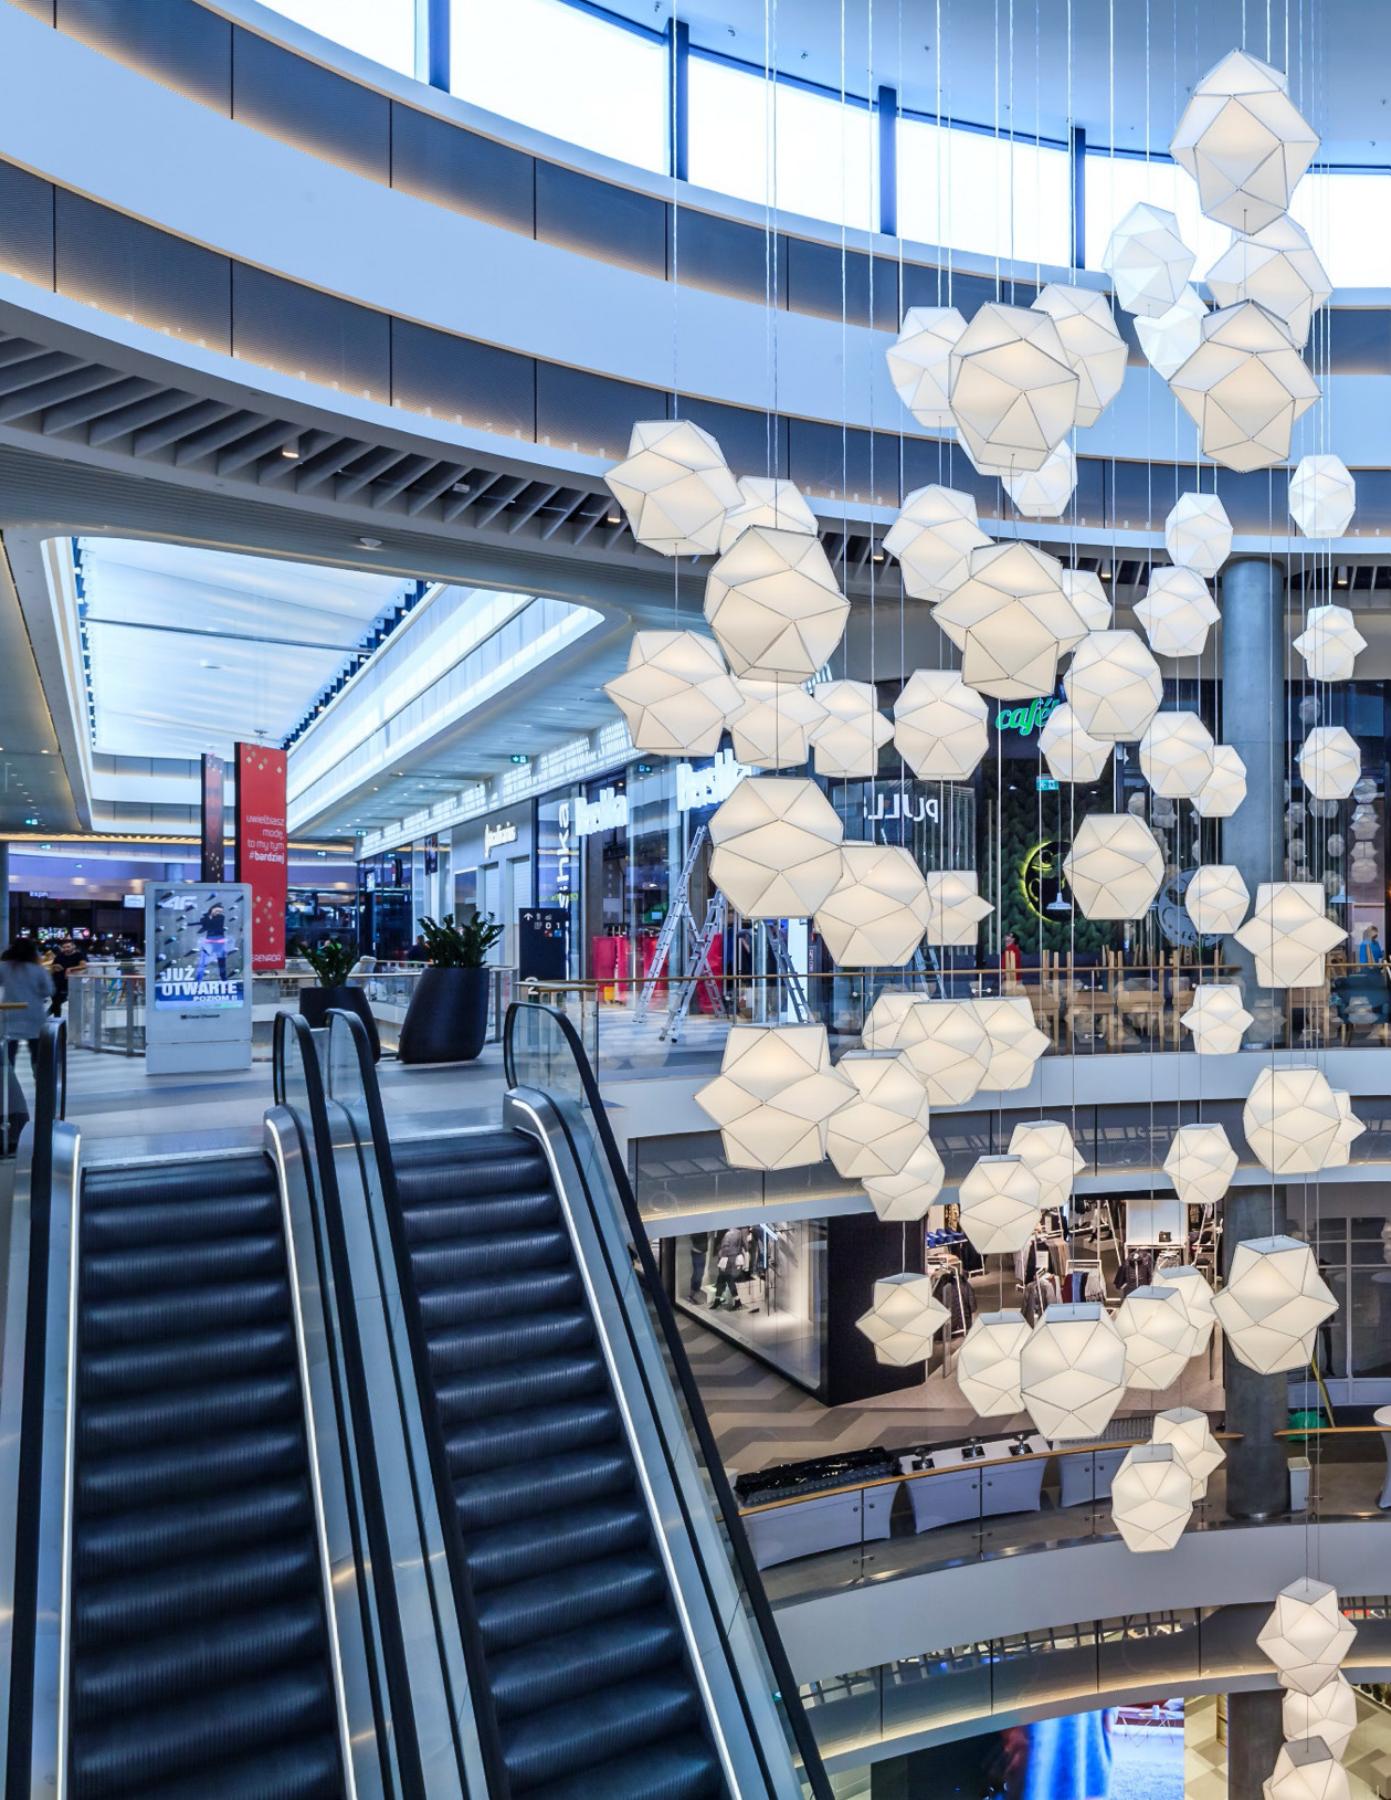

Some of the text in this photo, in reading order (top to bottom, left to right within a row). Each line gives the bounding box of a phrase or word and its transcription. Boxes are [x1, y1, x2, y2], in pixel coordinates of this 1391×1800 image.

[247, 839, 284, 851] to my tym
[248, 850, 285, 865] #bardziej
[161, 965, 195, 981] JUŻ
[161, 981, 238, 996] OTWARTE
